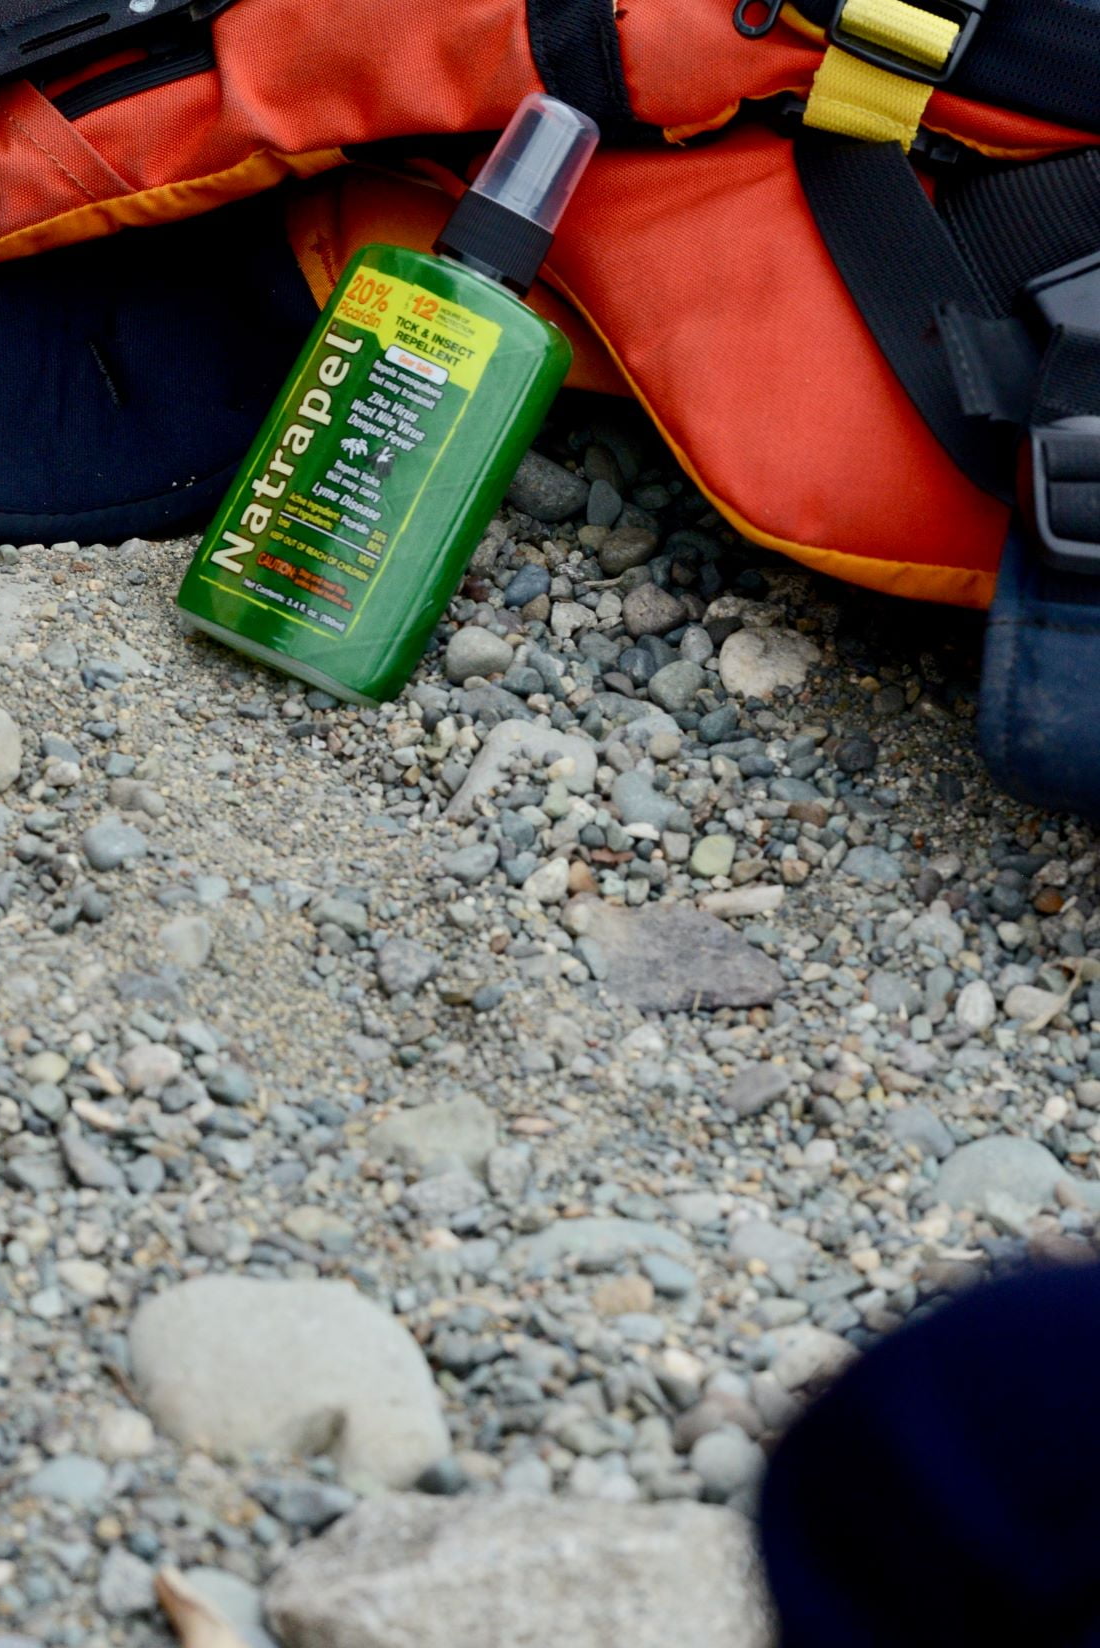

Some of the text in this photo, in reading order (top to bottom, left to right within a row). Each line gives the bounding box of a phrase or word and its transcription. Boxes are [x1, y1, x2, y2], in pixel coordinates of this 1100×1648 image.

[345, 274, 394, 313] 20%
[409, 293, 438, 320] 12
[338, 299, 382, 330] Picaridin
[395, 316, 418, 332] TICK
[421, 328, 429, 337] &
[431, 334, 474, 359] INSECT
[395, 331, 460, 366] REPELLENT
[373, 360, 397, 377] Repels
[367, 391, 419, 422] Zika Virus
[369, 373, 434, 408] that may transmit
[346, 412, 416, 451] Dengue Fever
[351, 399, 425, 441] West Nile Virus
[211, 332, 364, 575] Natrapel
[311, 481, 382, 521] Lyme Disease
[326, 470, 380, 502] that may carry
[286, 597, 299, 608] 3.4
